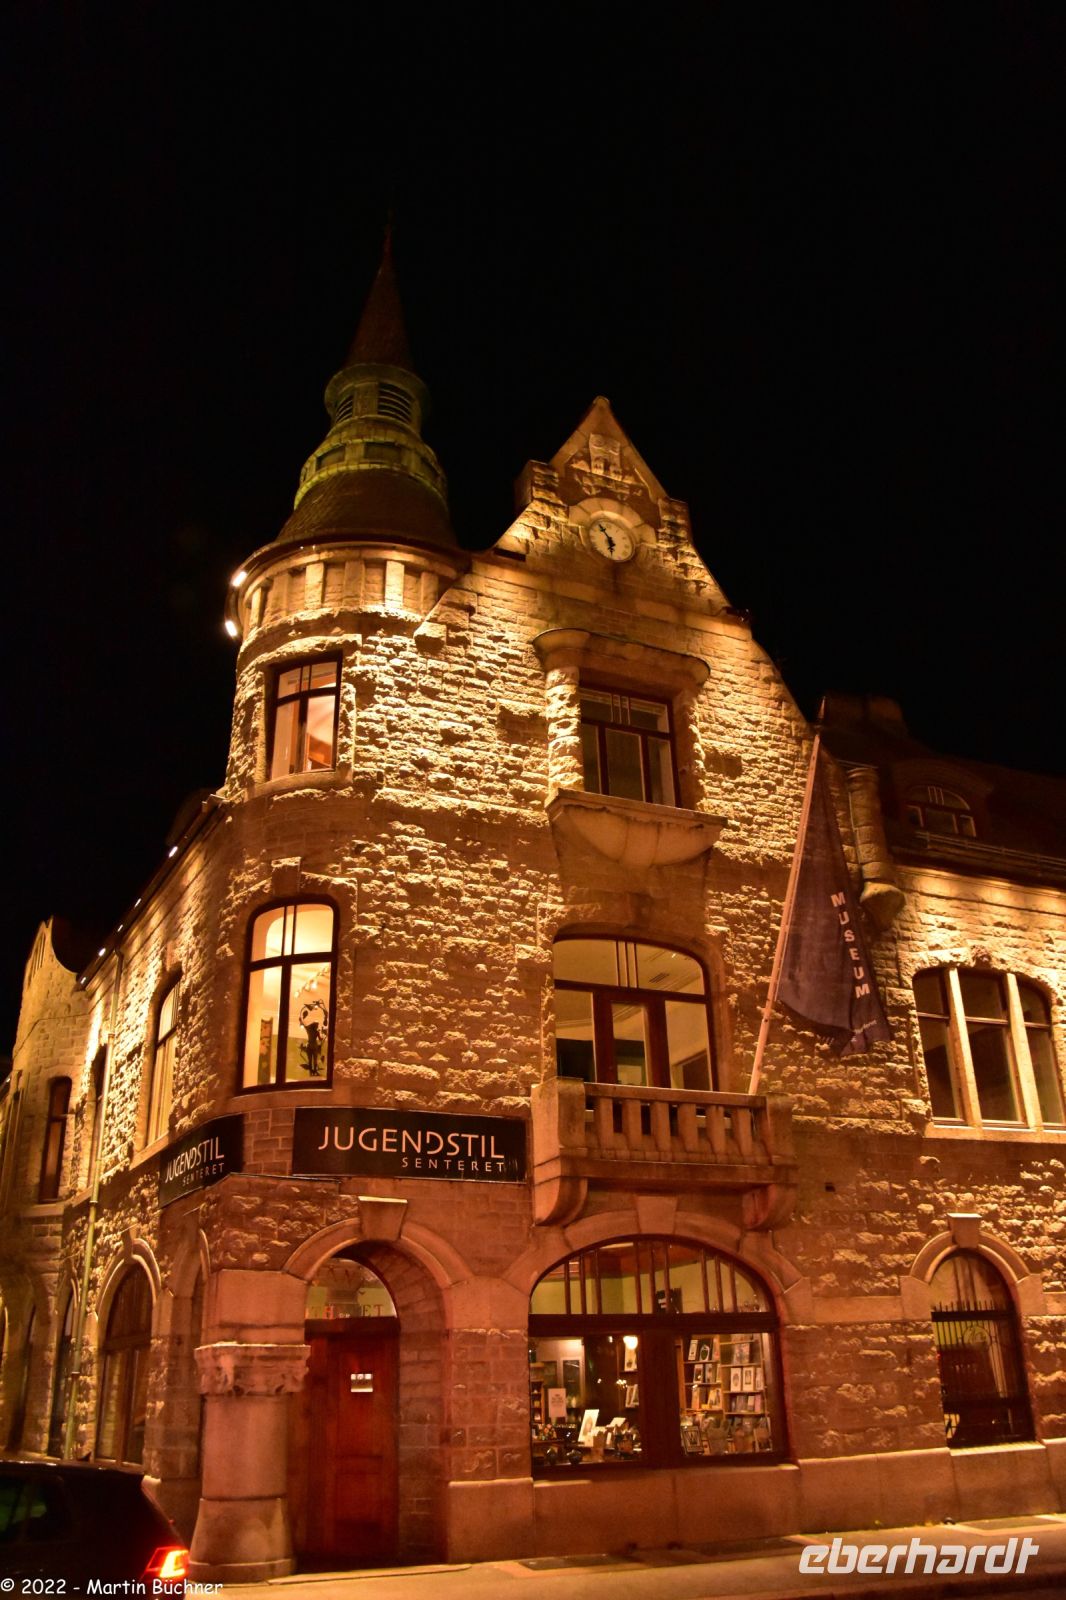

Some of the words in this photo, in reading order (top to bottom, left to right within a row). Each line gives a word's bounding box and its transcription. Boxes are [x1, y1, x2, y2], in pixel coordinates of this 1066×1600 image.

[830, 891, 871, 999] MUSEUM
[318, 1126, 505, 1159] JUGENDSTIL
[165, 1136, 225, 1183] JUGENDSTIL
[182, 1162, 225, 1187] SENTERET
[402, 1157, 505, 1172] SENTERET
